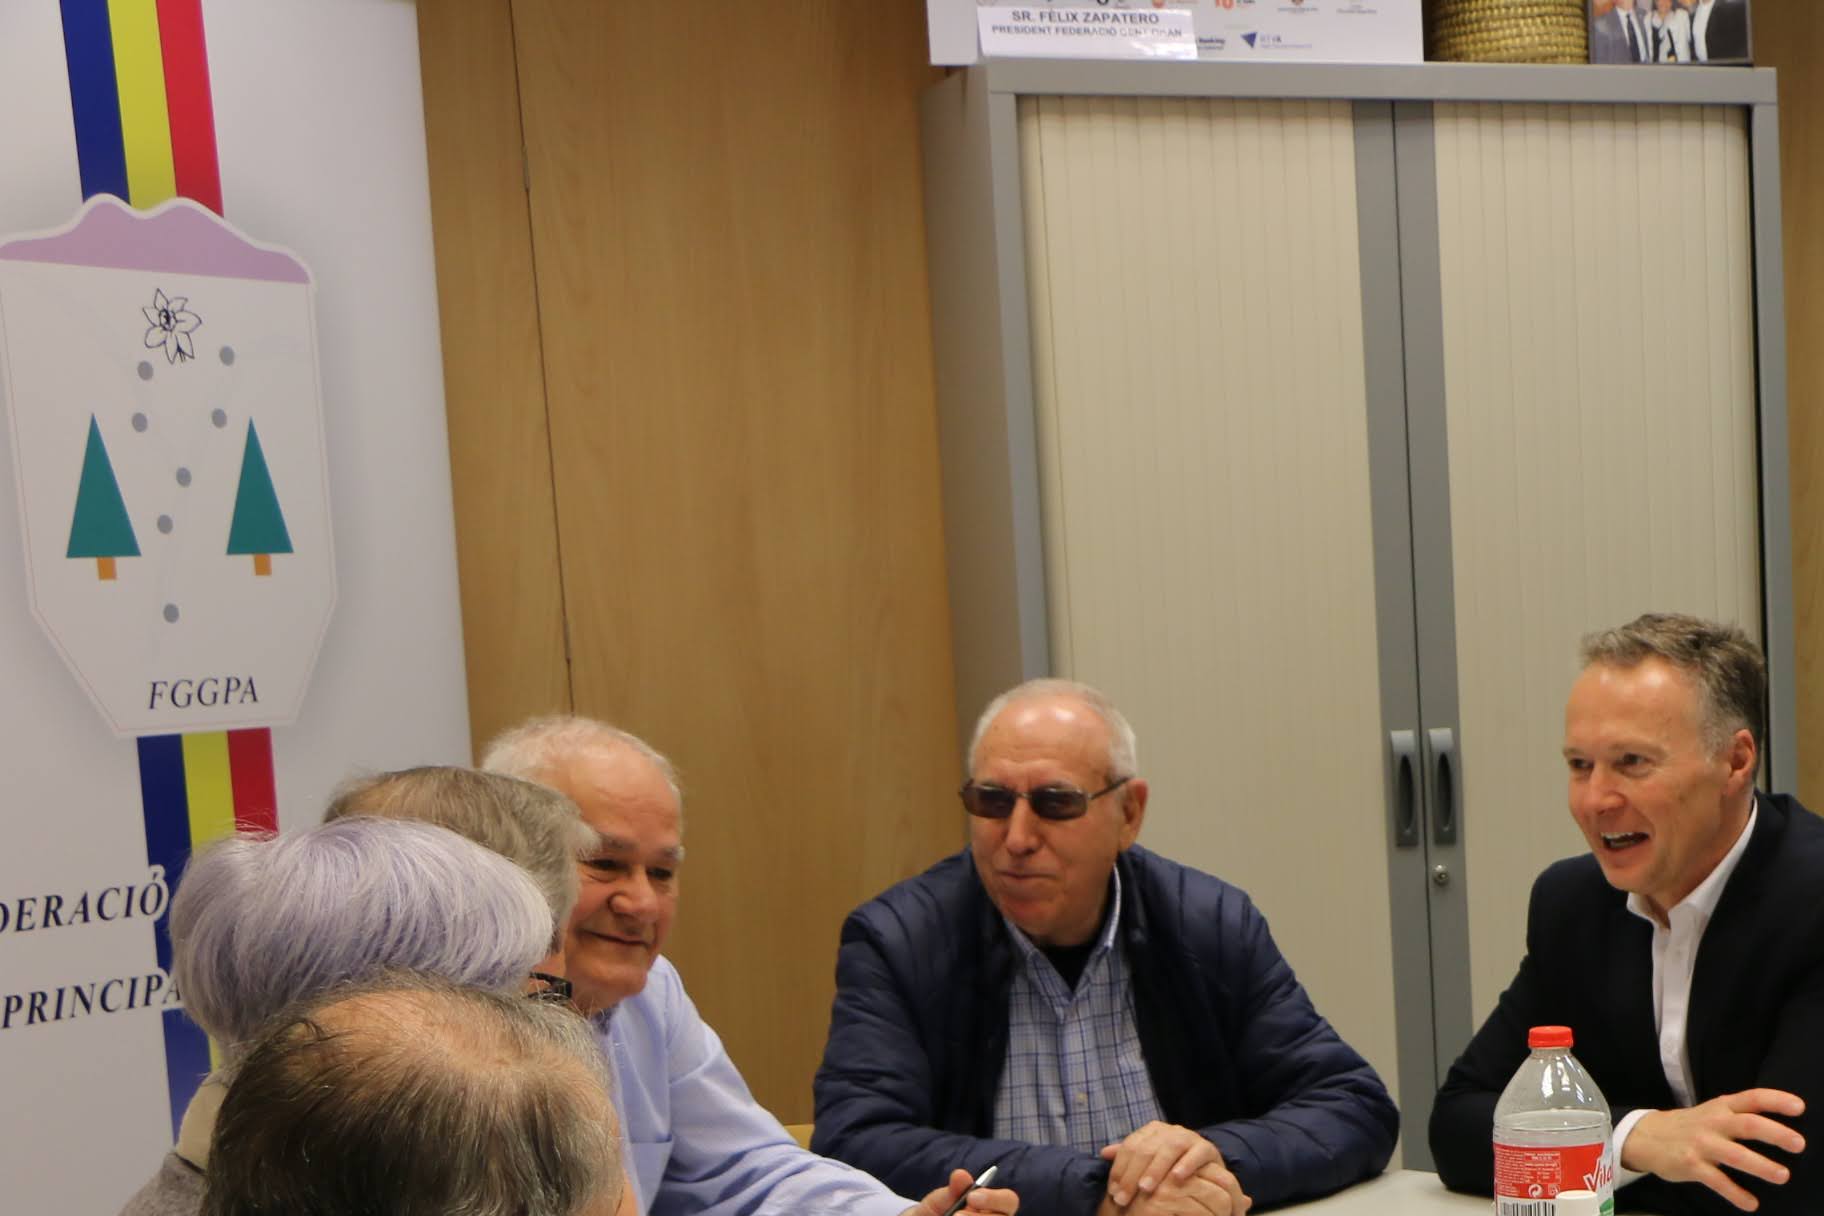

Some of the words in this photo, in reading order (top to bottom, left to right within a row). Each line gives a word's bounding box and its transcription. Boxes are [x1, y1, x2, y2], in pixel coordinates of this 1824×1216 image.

[1083, 11, 1159, 24] ZAPATERO
[991, 25, 1051, 34] PRESIDENT
[149, 676, 259, 709] FGGPA
